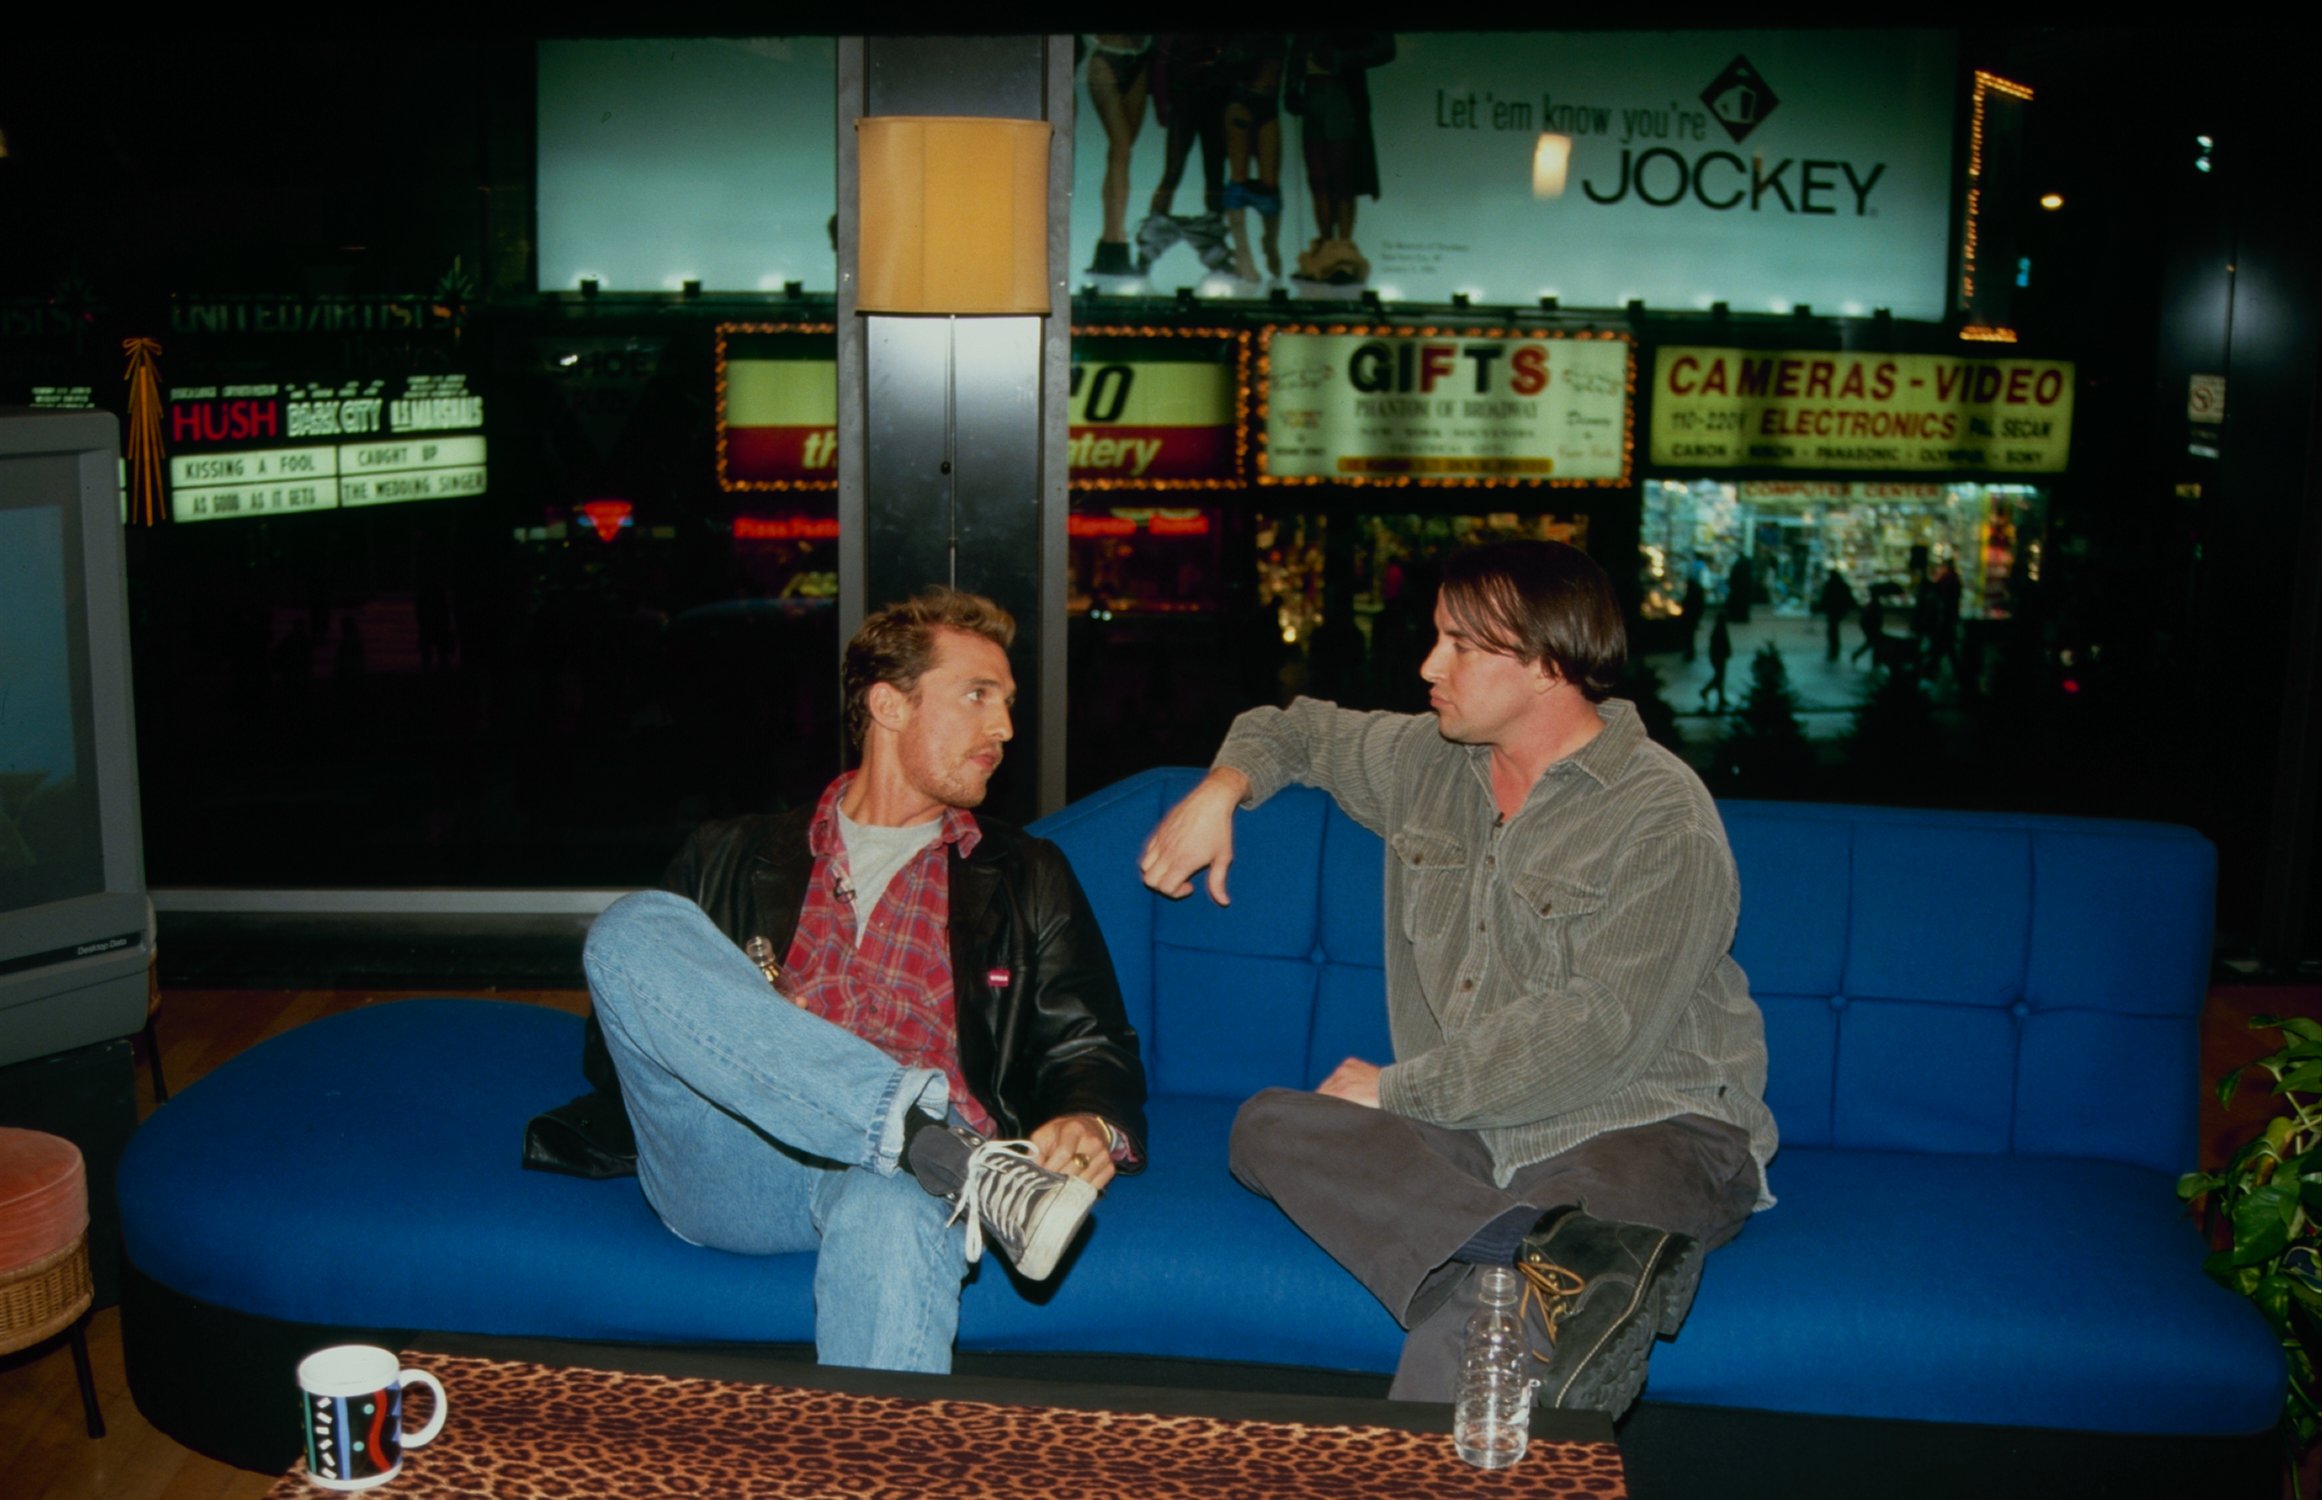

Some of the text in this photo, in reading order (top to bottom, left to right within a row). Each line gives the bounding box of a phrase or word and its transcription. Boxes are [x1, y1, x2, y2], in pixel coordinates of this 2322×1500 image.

[1435, 89, 1707, 143] Let 'em know you're
[1582, 147, 1886, 216] JOCKEY
[1347, 340, 1551, 396] GIFTS
[1667, 355, 1897, 401] CAMERAS
[1935, 364, 2063, 407] VIDEO
[172, 400, 278, 442] HUSH
[341, 398, 383, 435] CITY
[1760, 409, 1958, 440] ELECTRONICS
[185, 454, 316, 480] KISSING A FOOL
[358, 445, 439, 467] CAUGHT UP
[802, 431, 838, 469] th
[1670, 443, 1727, 458] CANON
[2005, 450, 2043, 465] SONY
[193, 495, 208, 515] AS
[251, 491, 265, 511] AS
[344, 471, 485, 499] THE WEDDING SINGER
